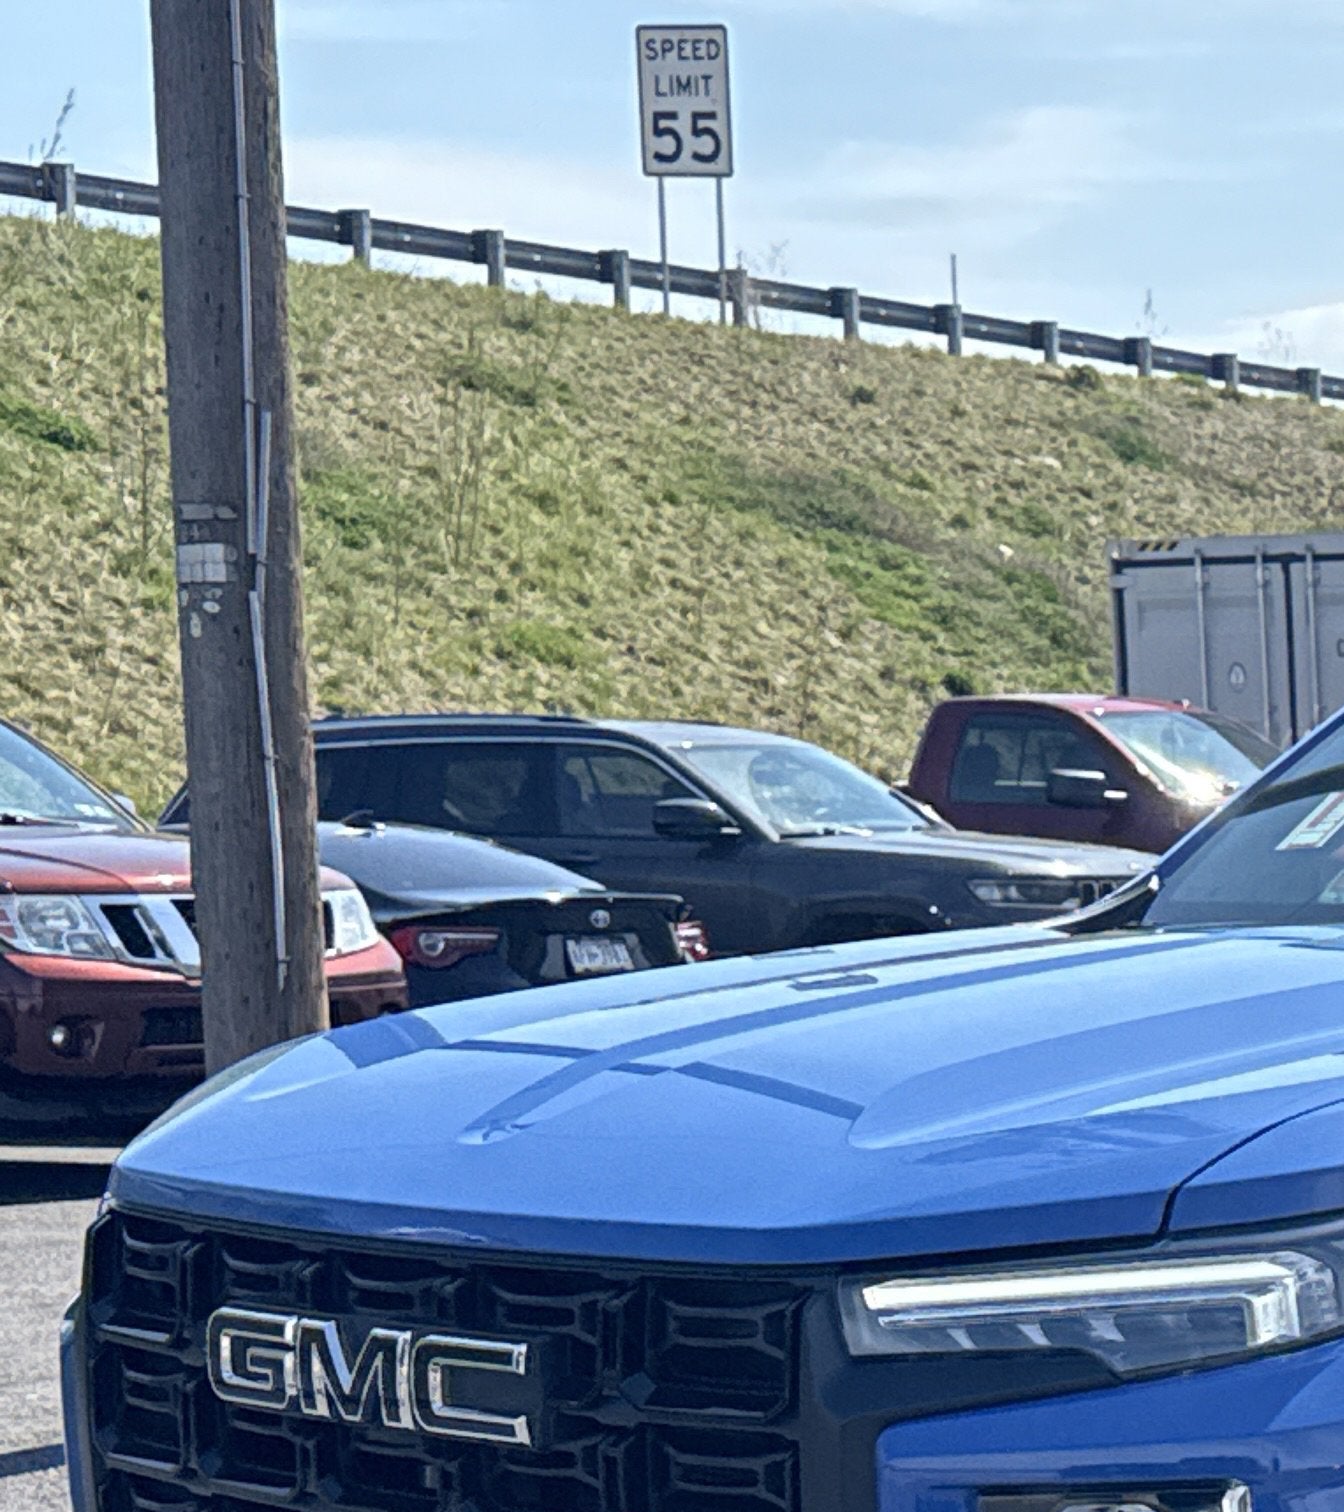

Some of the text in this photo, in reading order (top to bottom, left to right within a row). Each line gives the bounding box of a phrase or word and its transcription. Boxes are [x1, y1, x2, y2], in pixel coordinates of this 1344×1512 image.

[644, 38, 721, 61] SPEED
[654, 74, 713, 97] LIMIT
[652, 111, 721, 163] 55
[206, 1306, 531, 1446] GMC
